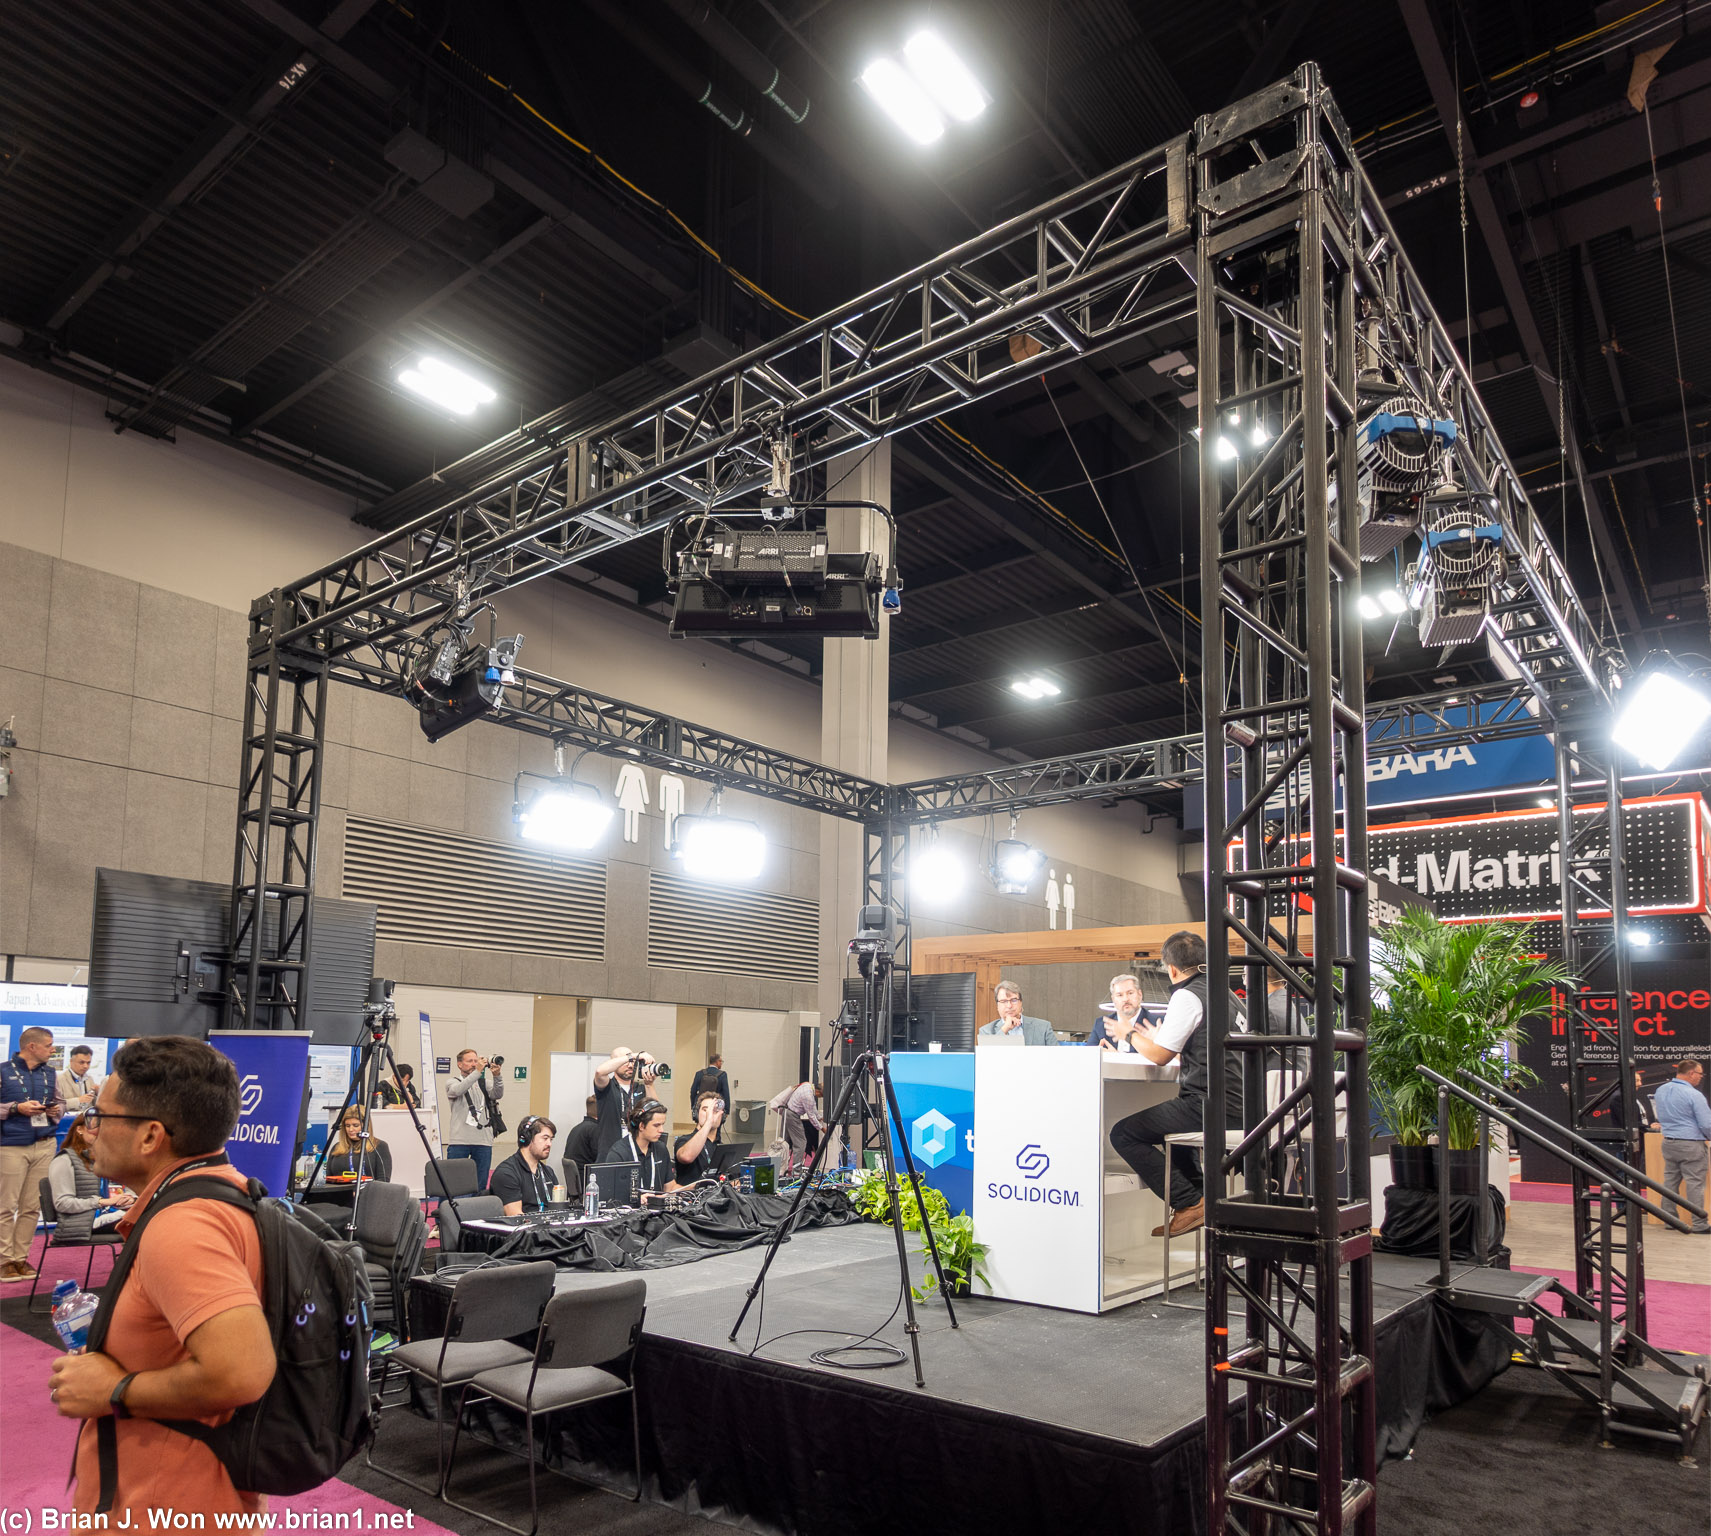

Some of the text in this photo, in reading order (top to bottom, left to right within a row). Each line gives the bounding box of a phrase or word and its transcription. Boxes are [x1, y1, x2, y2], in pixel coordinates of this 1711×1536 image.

[758, 547, 779, 556] ARRI
[1340, 744, 1477, 787] BARA
[4, 991, 30, 1009] Japan
[988, 1182, 1079, 1207] SOLIDIGM
